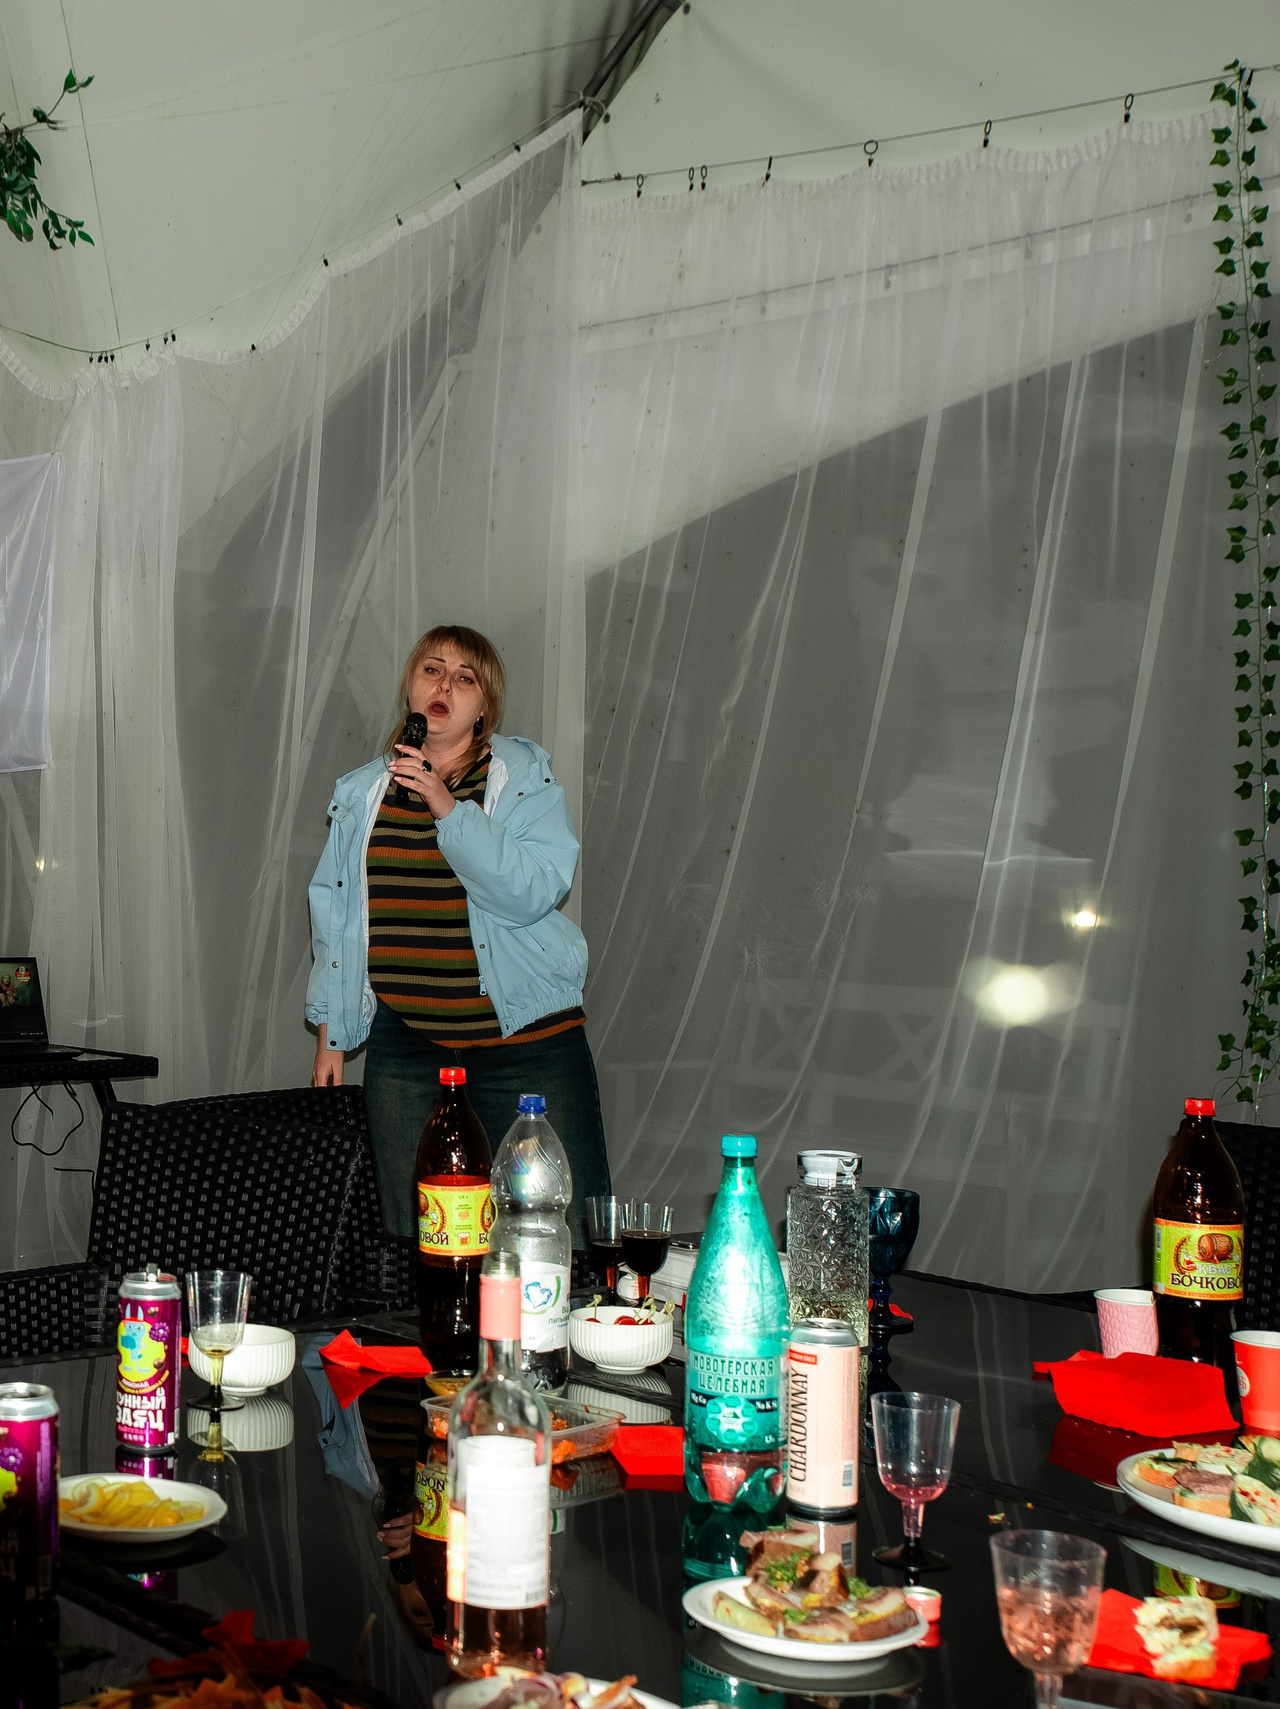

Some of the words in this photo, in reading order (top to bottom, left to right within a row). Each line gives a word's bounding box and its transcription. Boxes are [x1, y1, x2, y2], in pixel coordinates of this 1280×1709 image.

[419, 1231, 450, 1246] ОВОЙ
[1197, 1264, 1232, 1275] КВАС
[1170, 1273, 1243, 1291] БОЧКОВО
[693, 1353, 775, 1376] НОВОТЕРСКАЯ
[699, 1373, 767, 1395] ЦЕЛЕБНАЯ
[116, 1405, 164, 1431] ЗАЯЦ
[789, 1367, 808, 1482] CHARDONNAY
